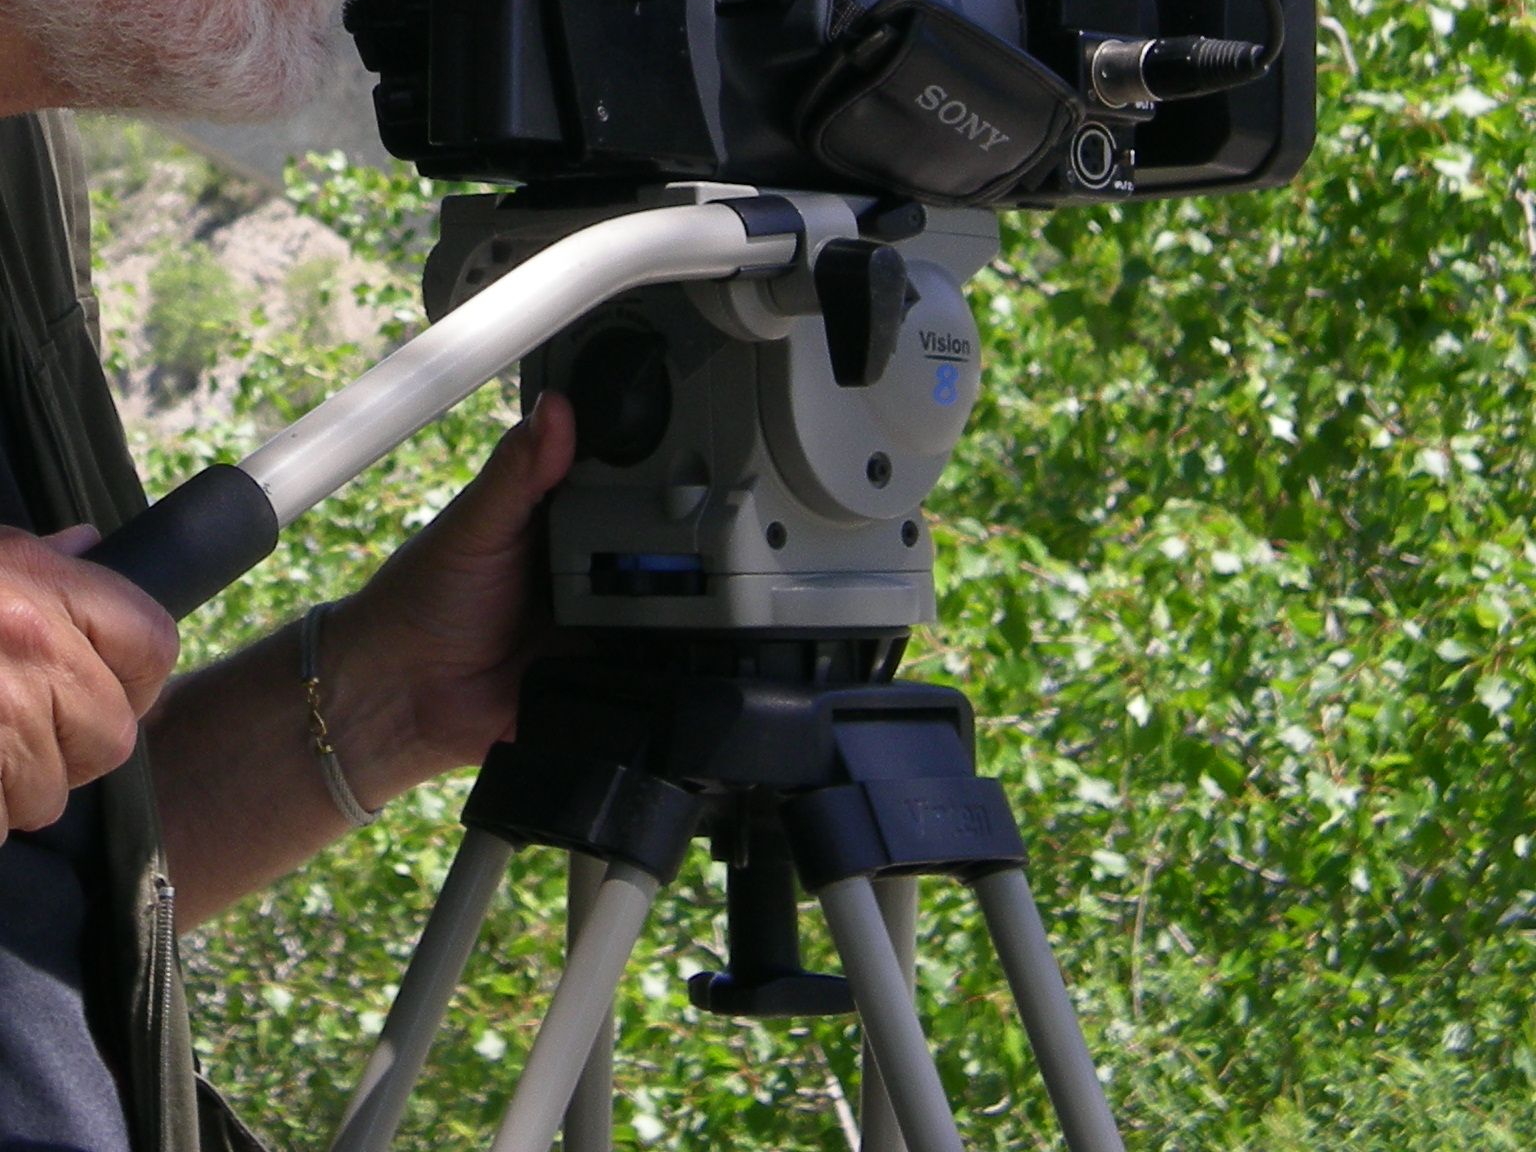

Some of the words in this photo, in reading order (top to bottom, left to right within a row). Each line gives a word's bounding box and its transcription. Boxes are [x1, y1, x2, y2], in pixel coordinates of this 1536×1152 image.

[914, 85, 1010, 152] SONY
[919, 330, 971, 355] Vision
[934, 363, 960, 406] 8
